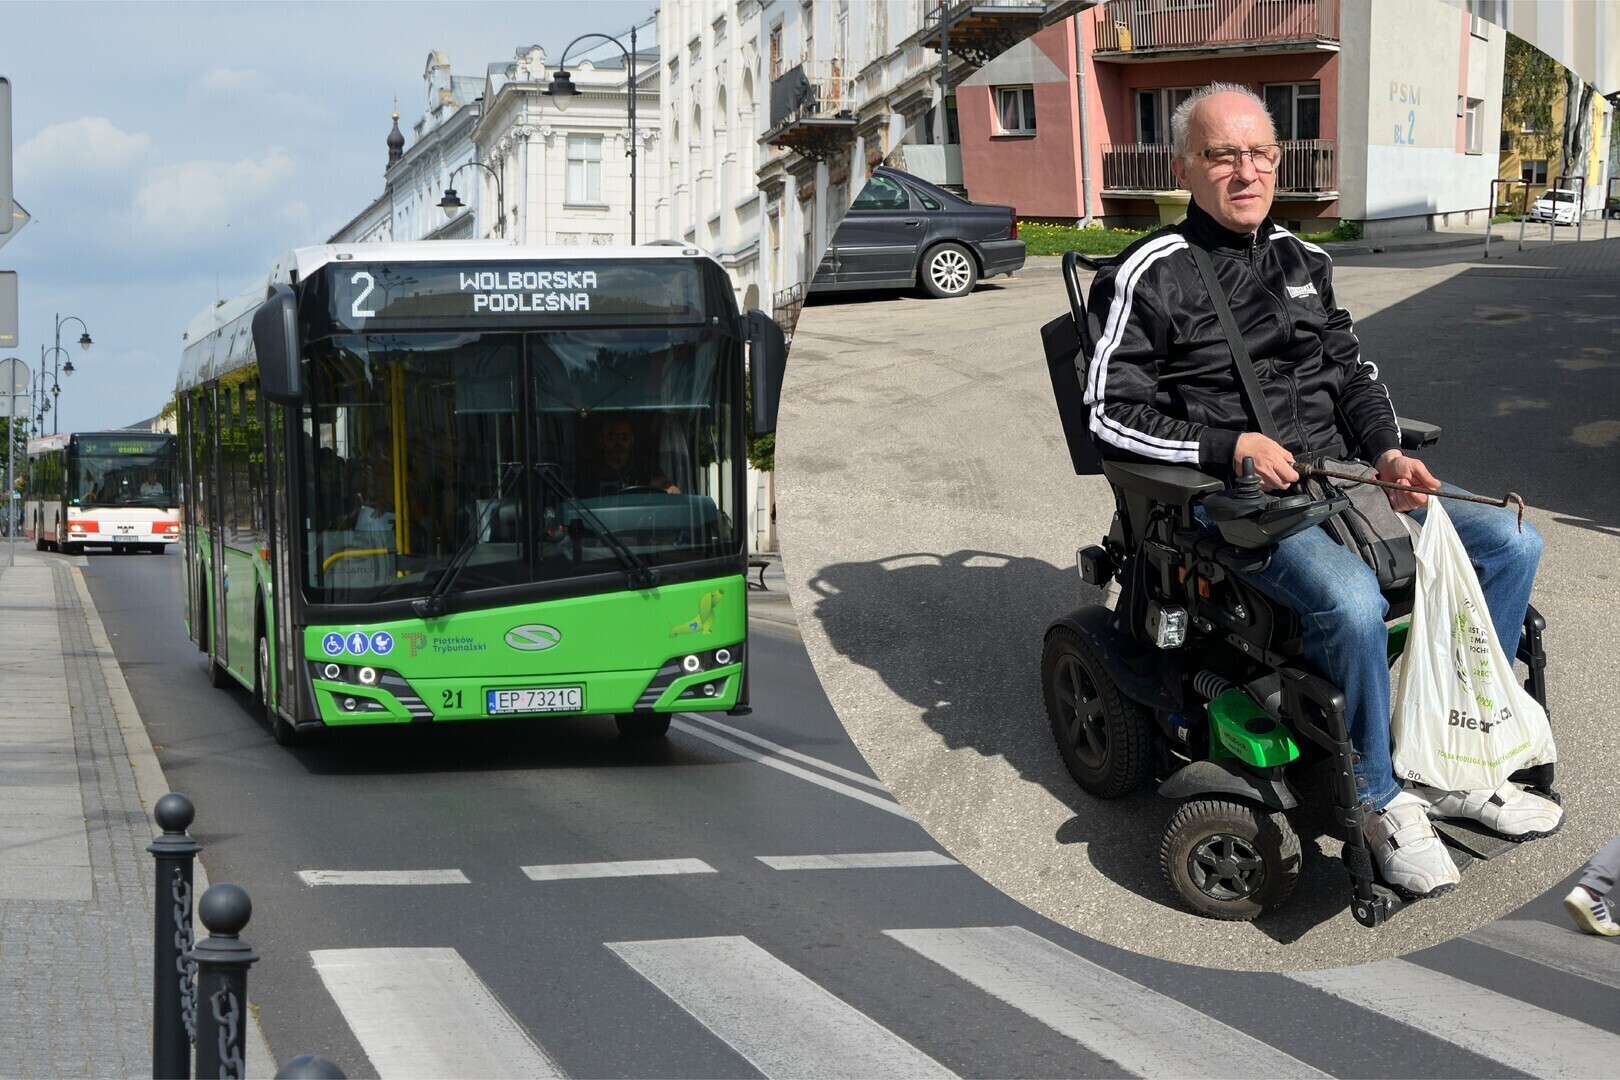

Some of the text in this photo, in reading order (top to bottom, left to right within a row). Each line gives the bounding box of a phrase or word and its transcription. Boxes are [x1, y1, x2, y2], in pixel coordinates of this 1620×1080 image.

[1390, 81, 1421, 105] PSM
[1408, 110, 1415, 144] 2
[459, 271, 597, 290] WOLBORSKA
[351, 271, 375, 317] 2
[474, 292, 590, 312] PODLEŚNA
[433, 636, 474, 645] Piotrków
[433, 643, 487, 654] Trybunalski
[442, 689, 464, 709] 21
[499, 692, 520, 709] EP
[526, 689, 577, 708] 7321C
